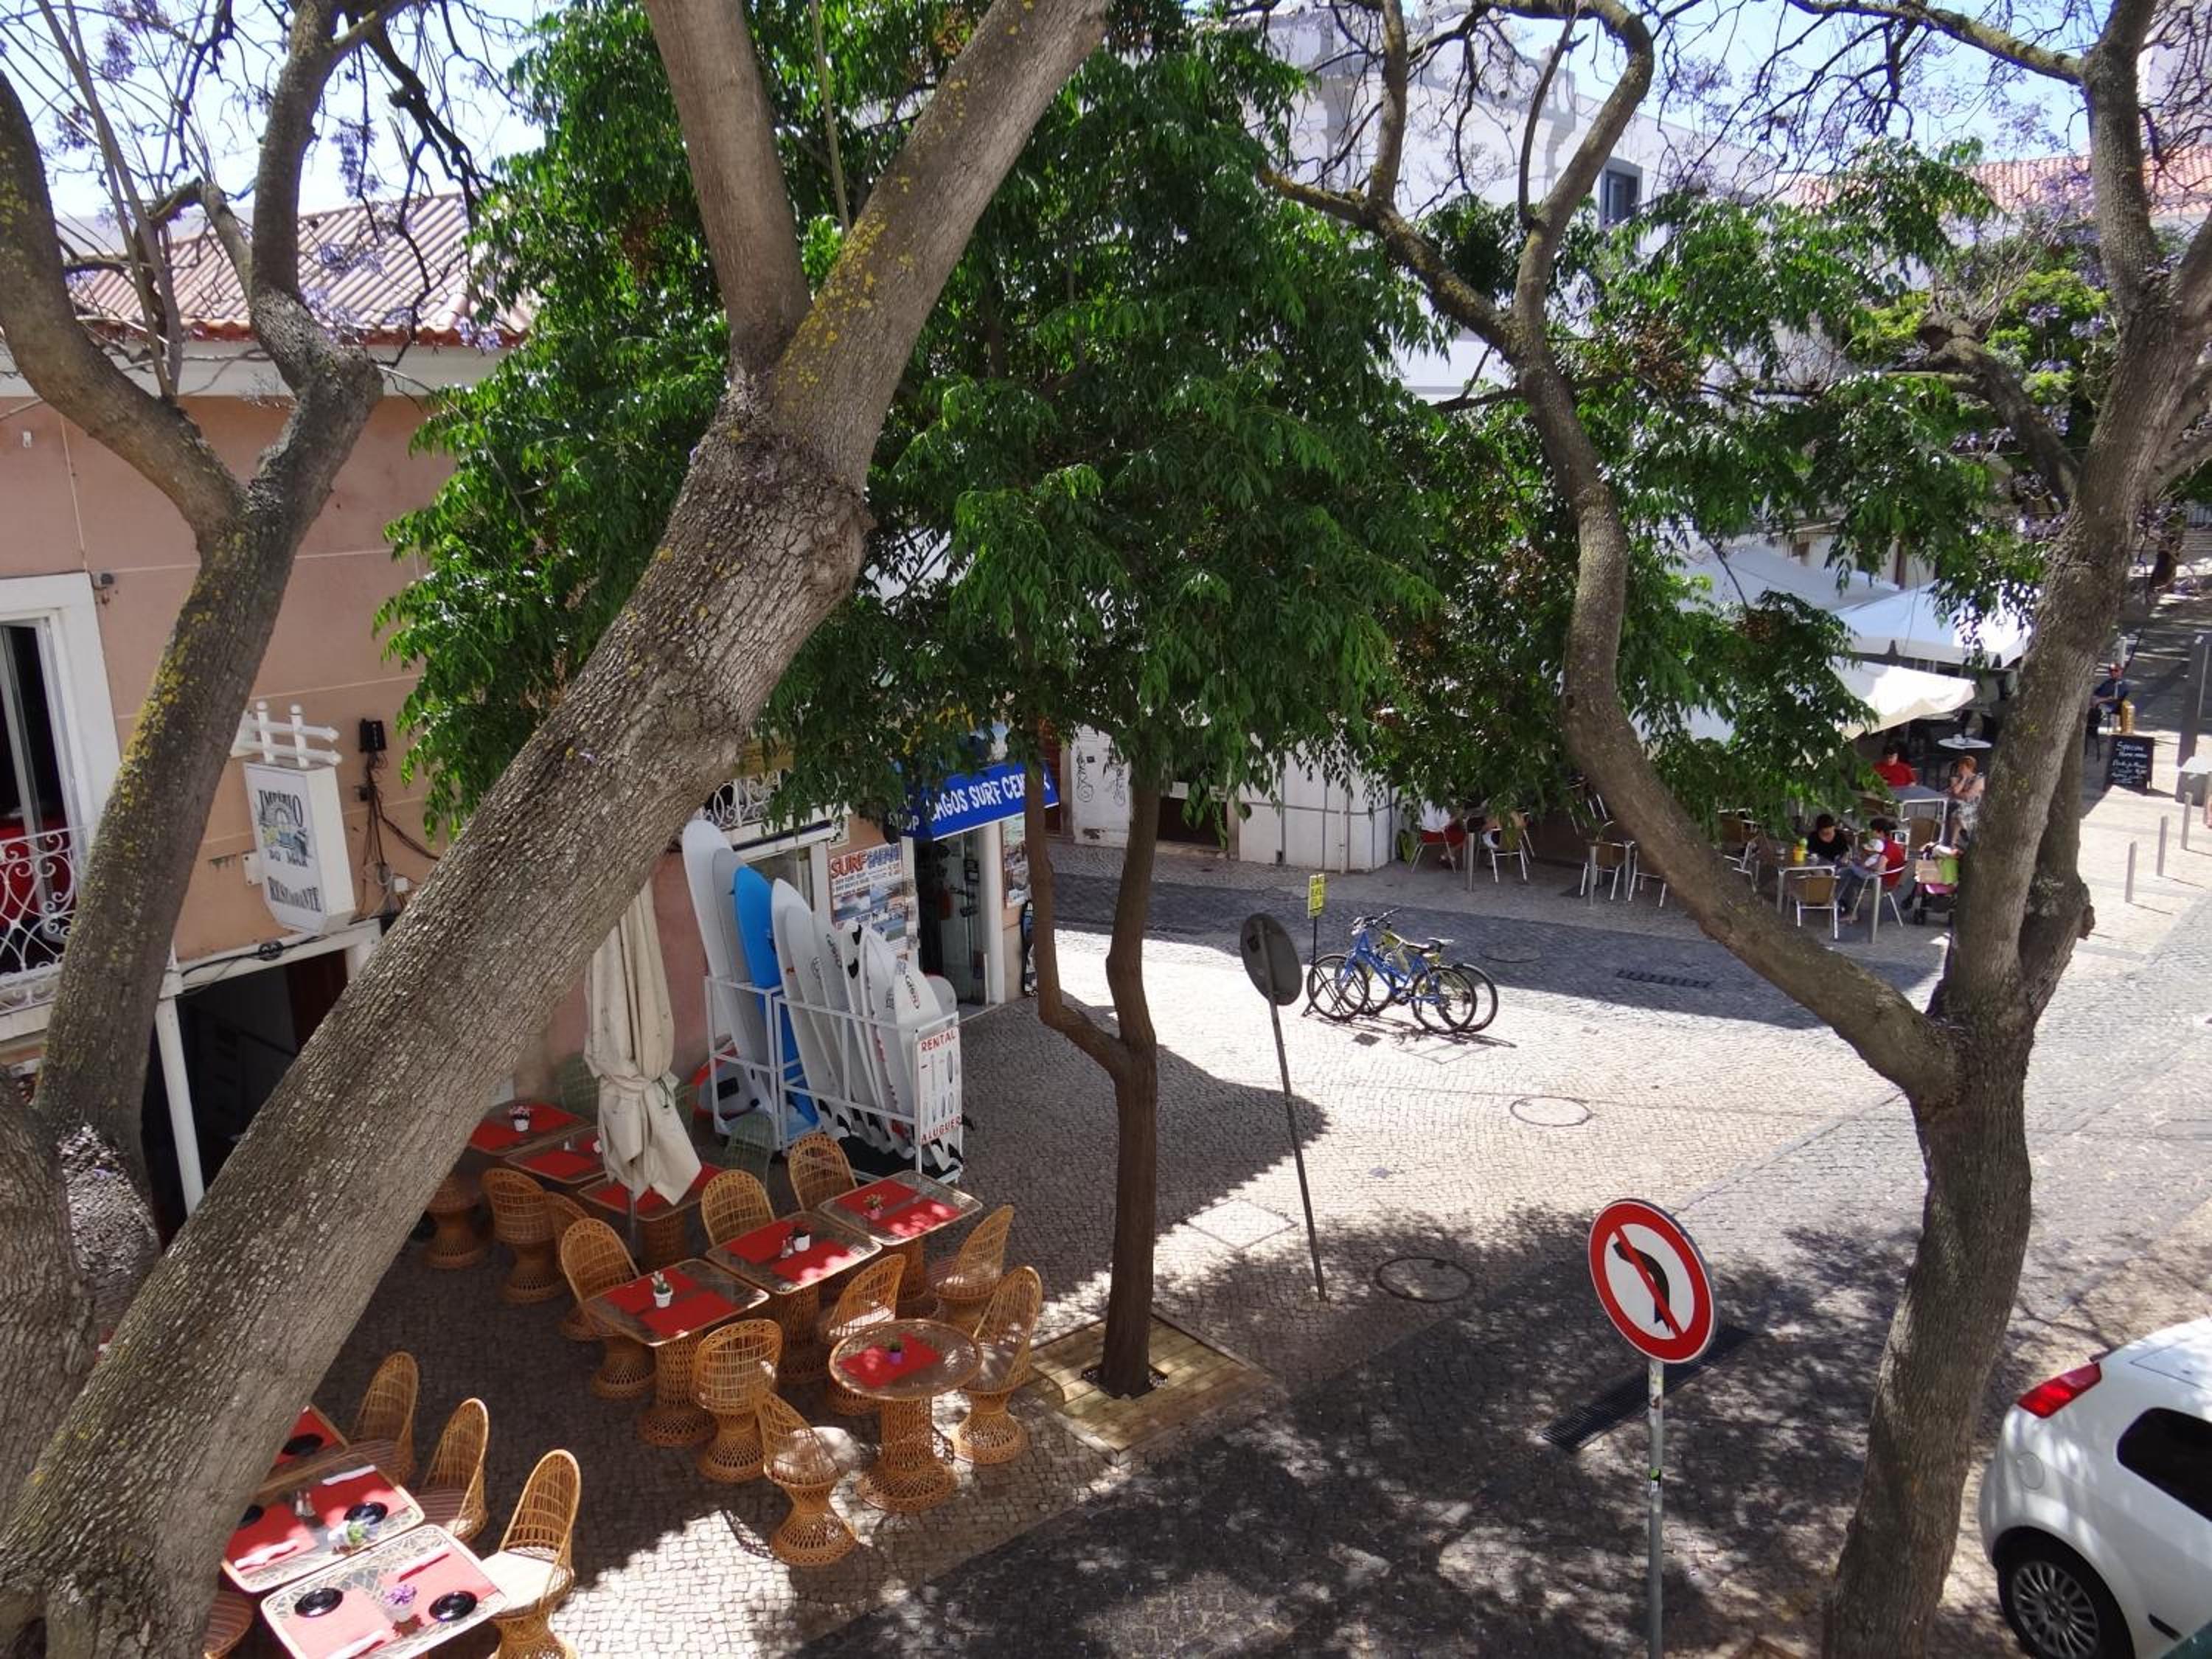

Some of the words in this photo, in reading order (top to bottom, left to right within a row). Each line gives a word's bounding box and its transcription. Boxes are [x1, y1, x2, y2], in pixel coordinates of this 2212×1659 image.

[969, 780, 1003, 810] SURF
[830, 852, 867, 877] SURF
[920, 1029, 956, 1052] RENTAL
[920, 1114, 962, 1144] ALUGUER
